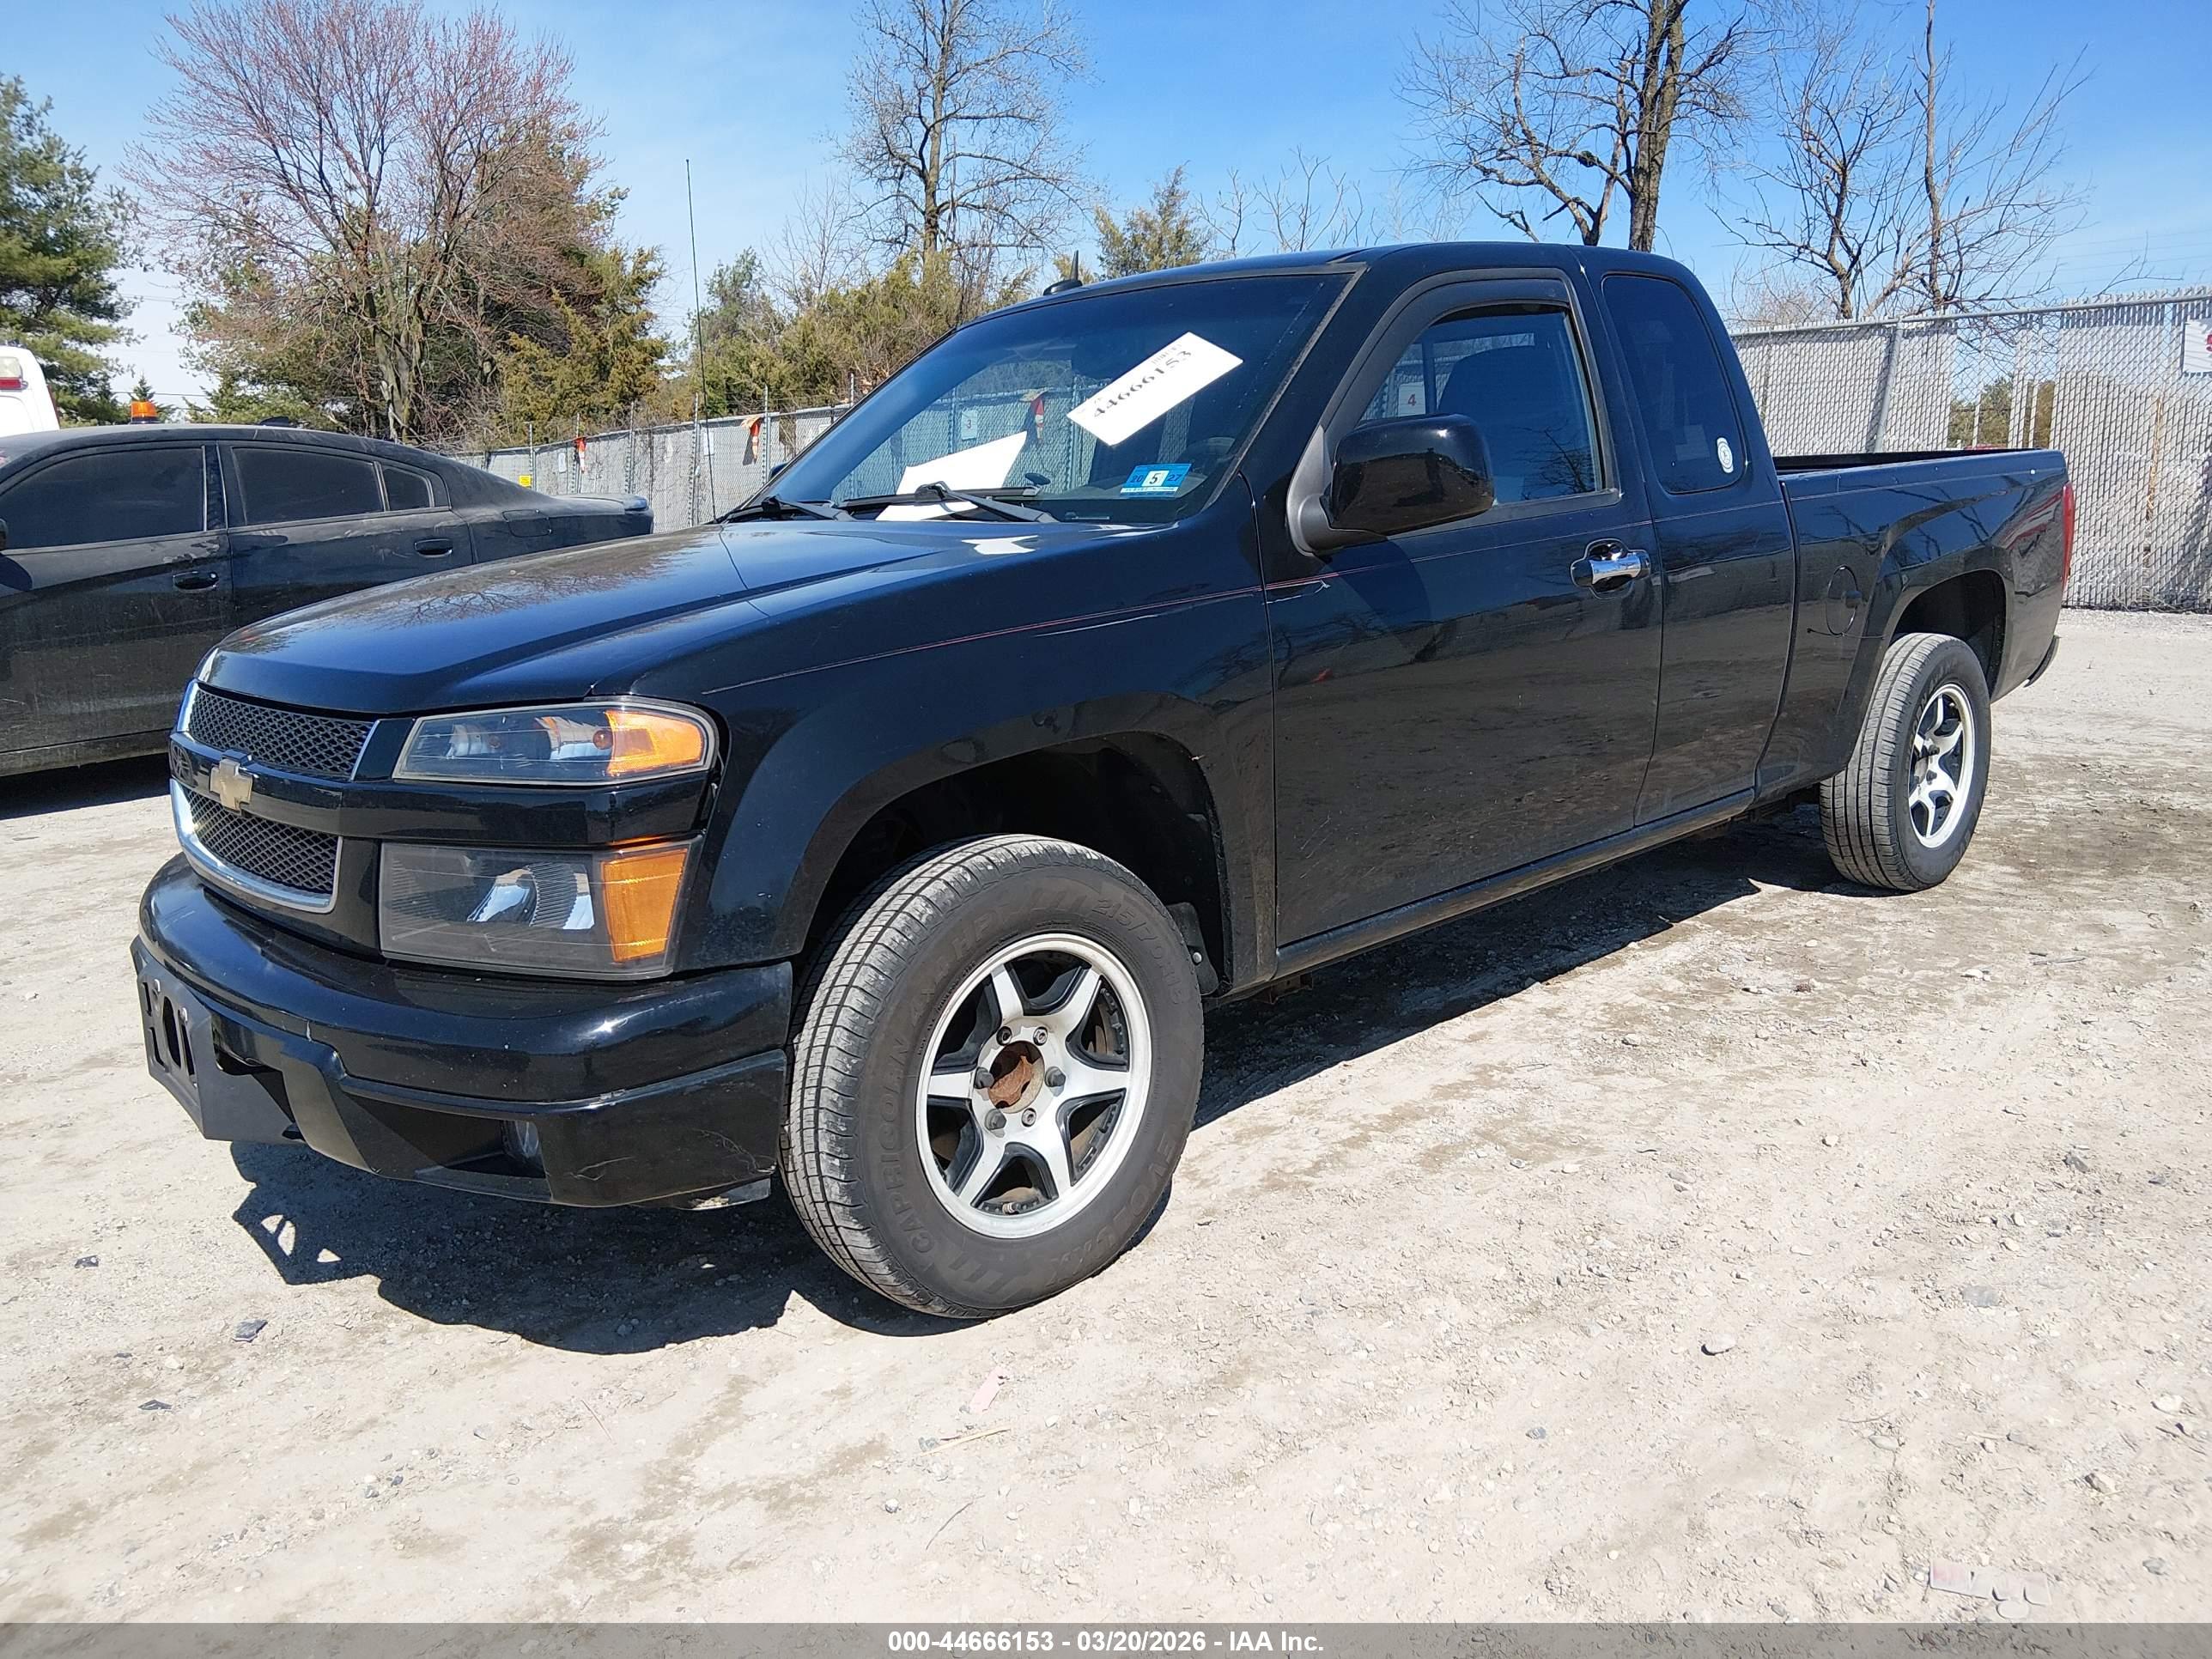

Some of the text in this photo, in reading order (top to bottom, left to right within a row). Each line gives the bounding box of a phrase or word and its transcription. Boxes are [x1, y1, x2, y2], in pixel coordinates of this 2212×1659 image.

[1094, 350, 1192, 417] 44666153
[1408, 394, 1416, 406] 4
[967, 419, 972, 429] 3
[1149, 472, 1162, 484] 5
[878, 1037, 935, 1253] CAPRICORN
